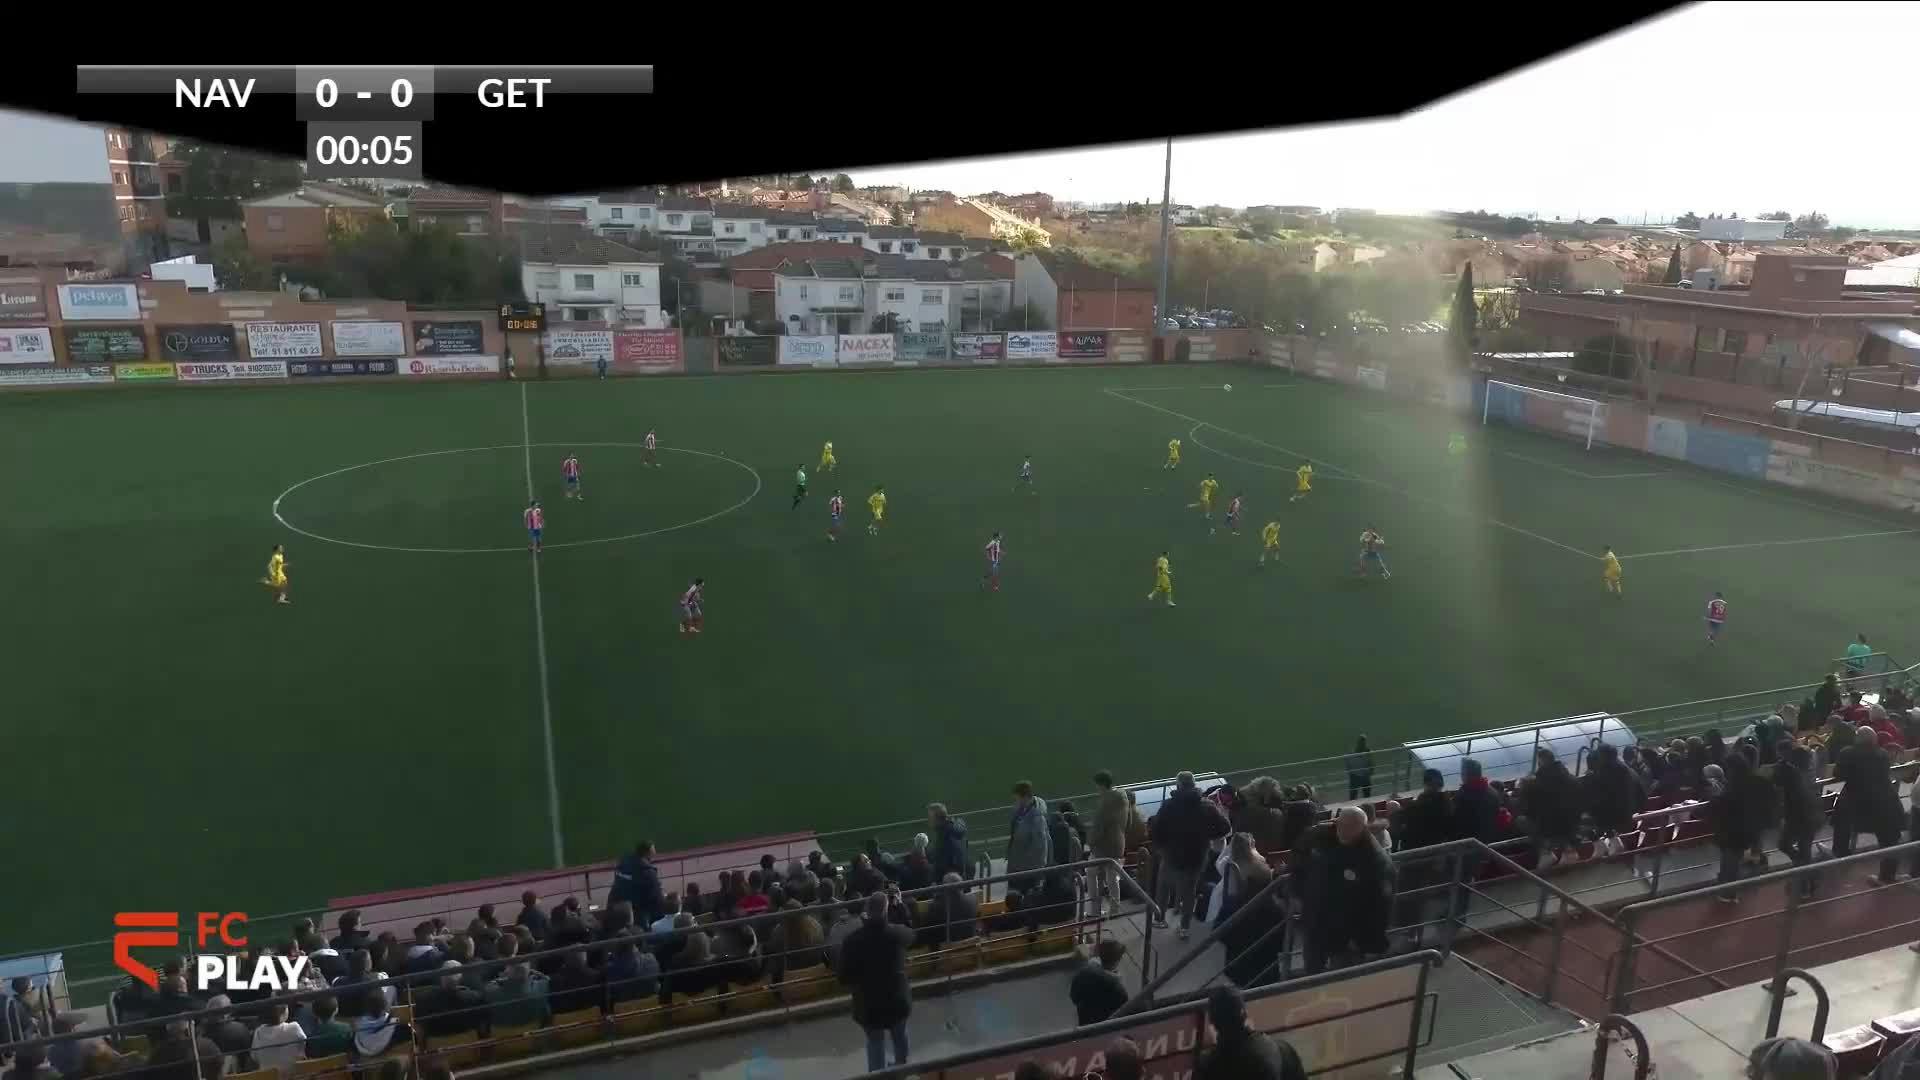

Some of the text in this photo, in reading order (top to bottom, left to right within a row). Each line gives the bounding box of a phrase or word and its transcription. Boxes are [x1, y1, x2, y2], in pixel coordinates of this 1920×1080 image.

[250, 325, 317, 333] RESTAURANTE
[190, 335, 231, 345] GOLDEN
[842, 337, 891, 352] NACEX
